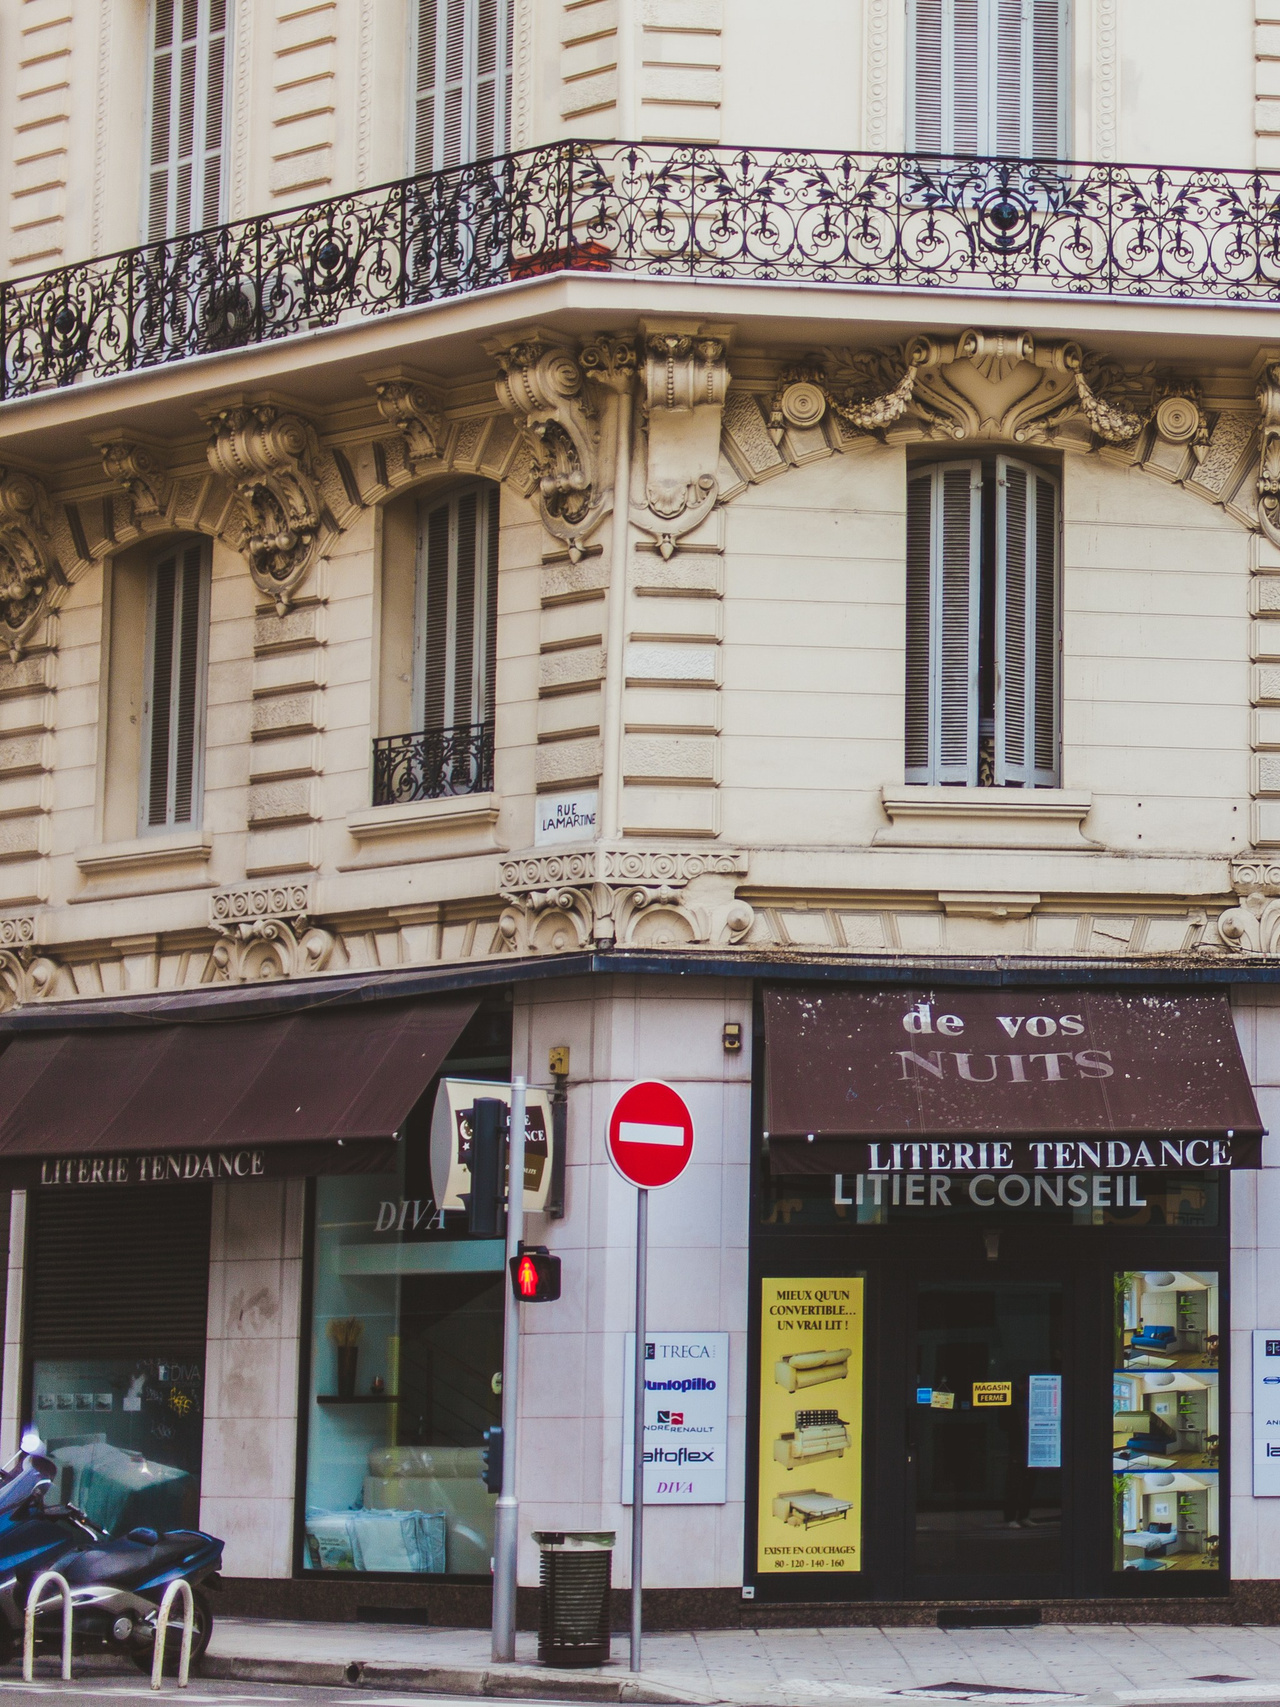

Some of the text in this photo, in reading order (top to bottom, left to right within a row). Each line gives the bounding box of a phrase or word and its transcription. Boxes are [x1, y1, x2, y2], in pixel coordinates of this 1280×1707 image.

[557, 803, 577, 816] RUE
[543, 813, 596, 831] LAMARTINE
[902, 1003, 1085, 1038] de vos
[896, 1050, 1115, 1083] NUITS
[868, 1140, 1233, 1171] LITERIE TENDANCE
[41, 1150, 265, 1185] LITERIE TENDANCE
[834, 1174, 1147, 1208] LITIER CONSEIL
[373, 1200, 446, 1232] DIVA
[777, 1290, 849, 1302] MIEUX QU'UN
[777, 1320, 794, 1330] UN
[796, 1320, 822, 1330] VRAI
[825, 1320, 843, 1330] LIT
[660, 1345, 710, 1358] TRECA
[643, 1448, 714, 1465] attoflex
[656, 1482, 694, 1493] DIVA
[764, 1547, 792, 1555] EXISTE
[805, 1546, 856, 1554] COUCHAGES
[774, 1560, 784, 1568] 80
[791, 1560, 805, 1568] 120
[831, 1559, 845, 1567] 160
